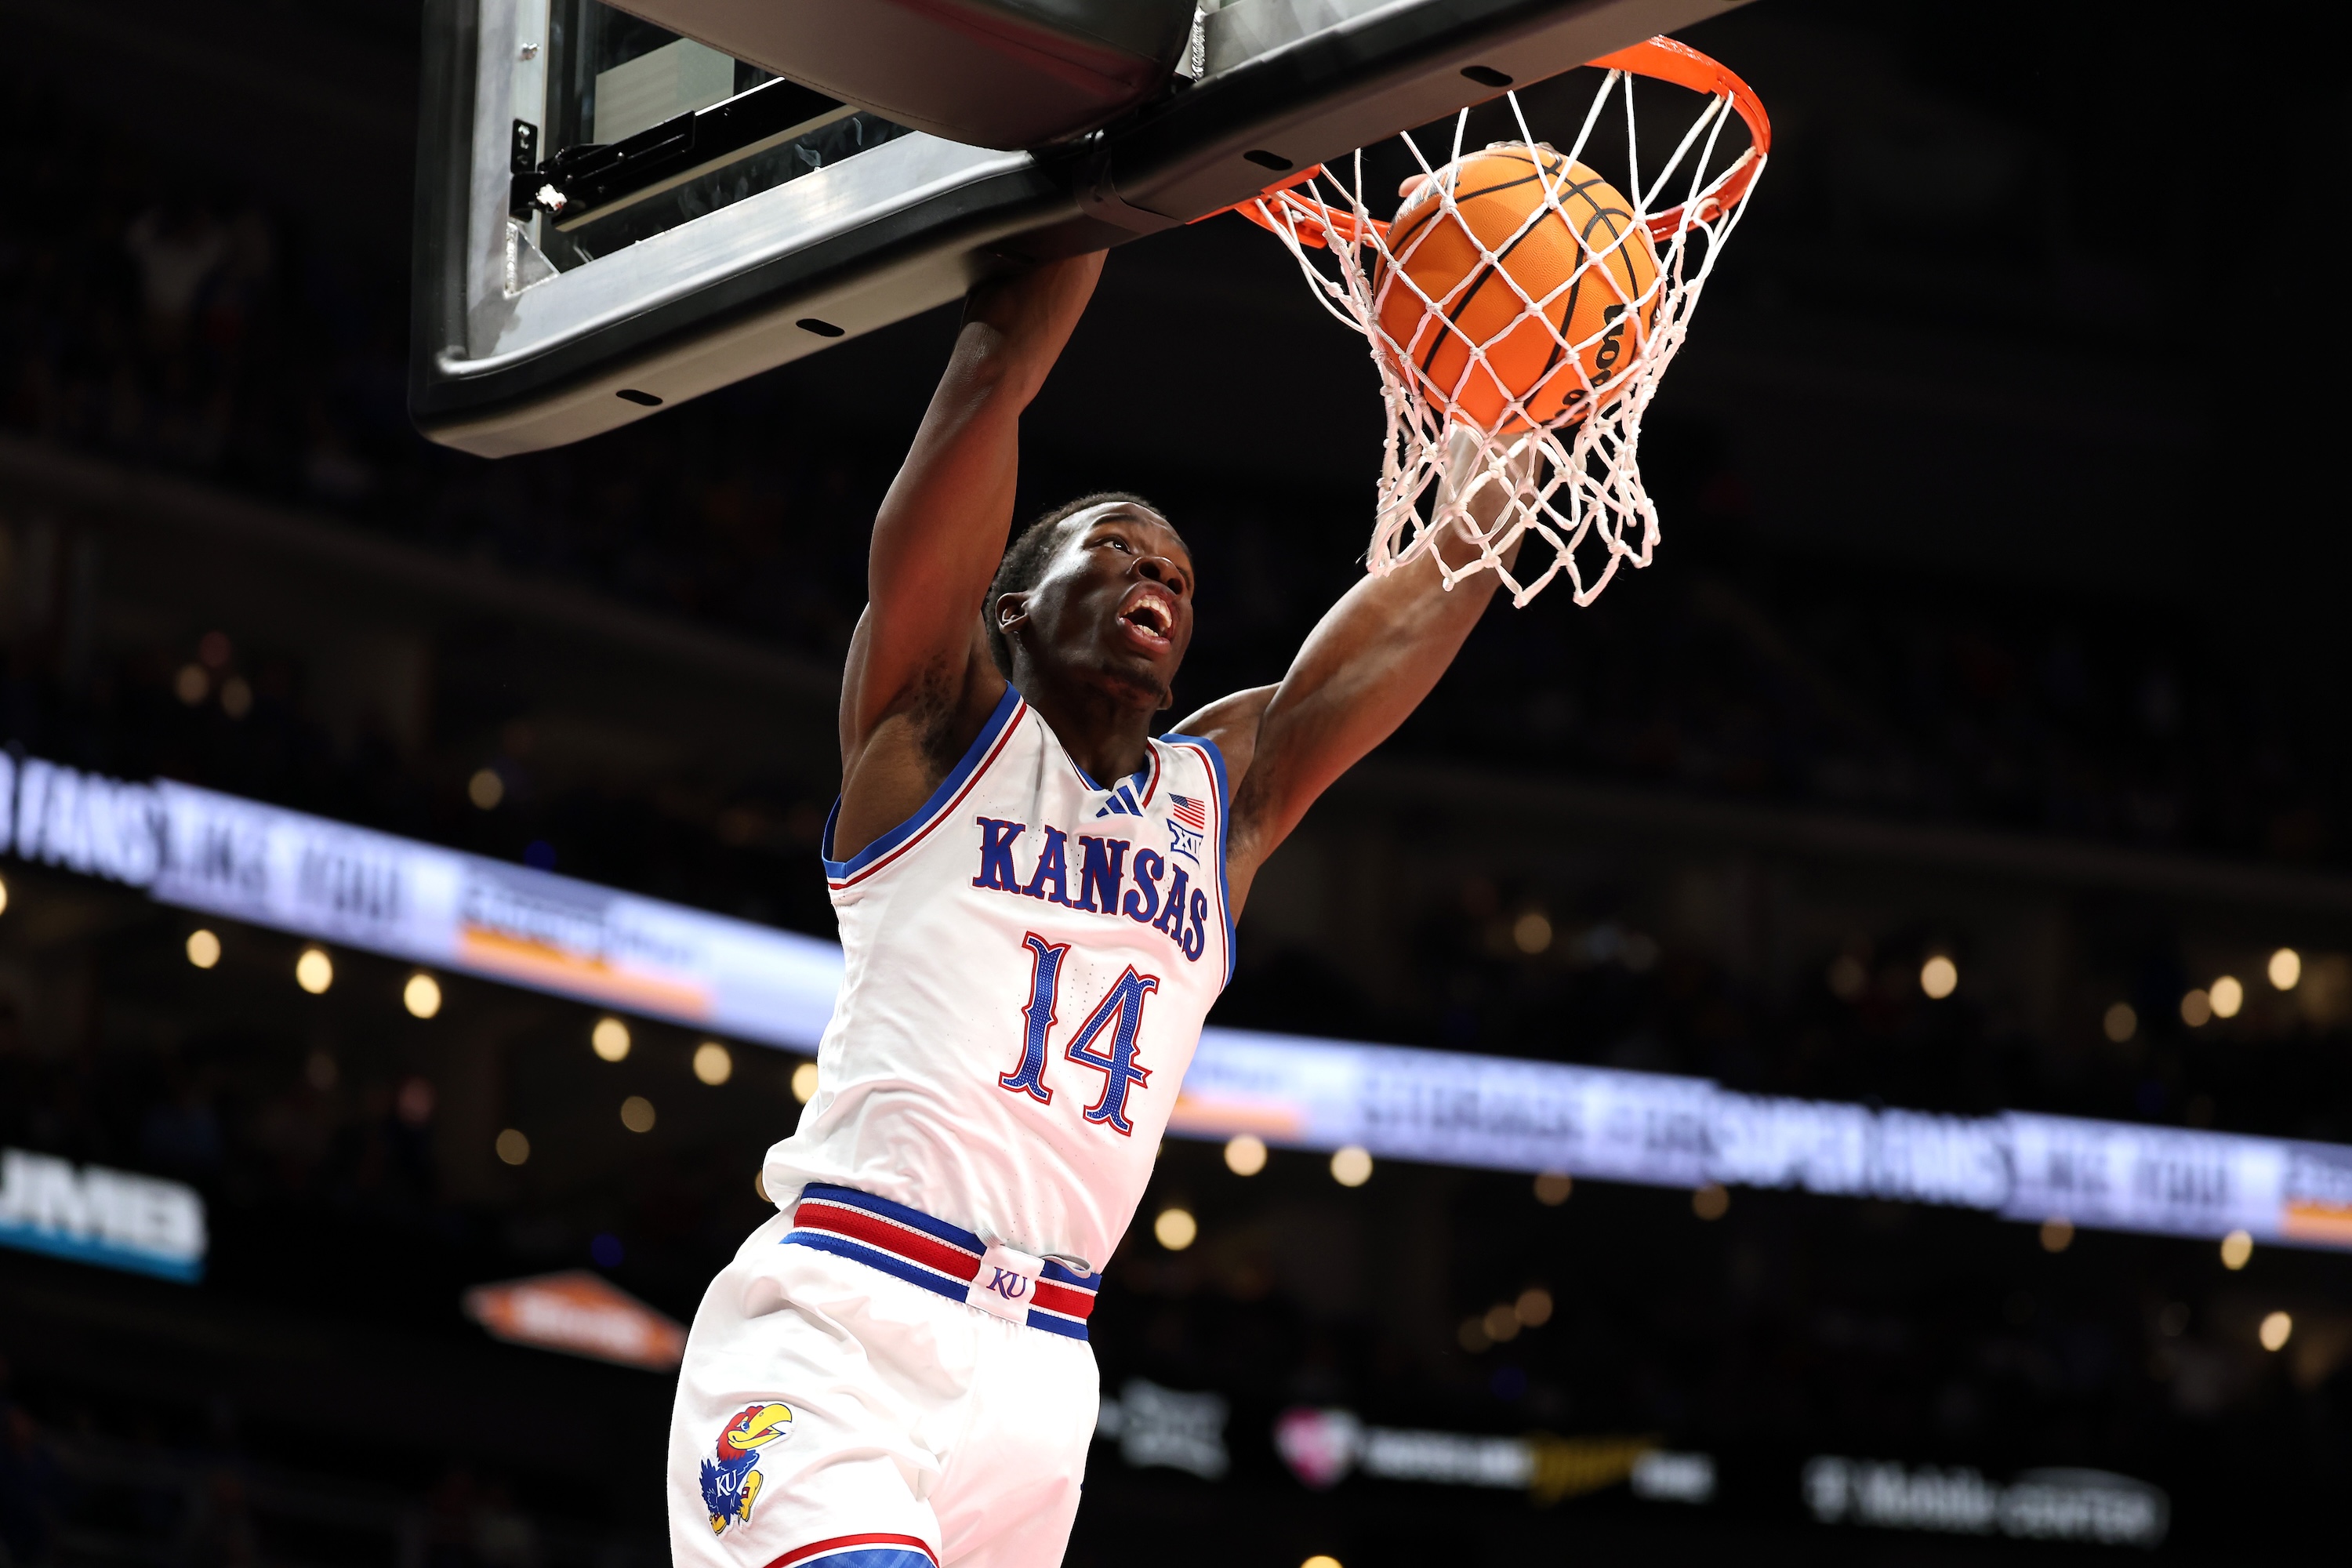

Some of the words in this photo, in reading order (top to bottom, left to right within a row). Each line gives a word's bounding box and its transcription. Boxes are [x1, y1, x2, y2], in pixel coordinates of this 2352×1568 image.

[972, 816, 1207, 962] KANSAS
[998, 931, 1160, 1137] 14
[986, 1266, 1028, 1300] KU
[714, 1469, 738, 1497] KU
